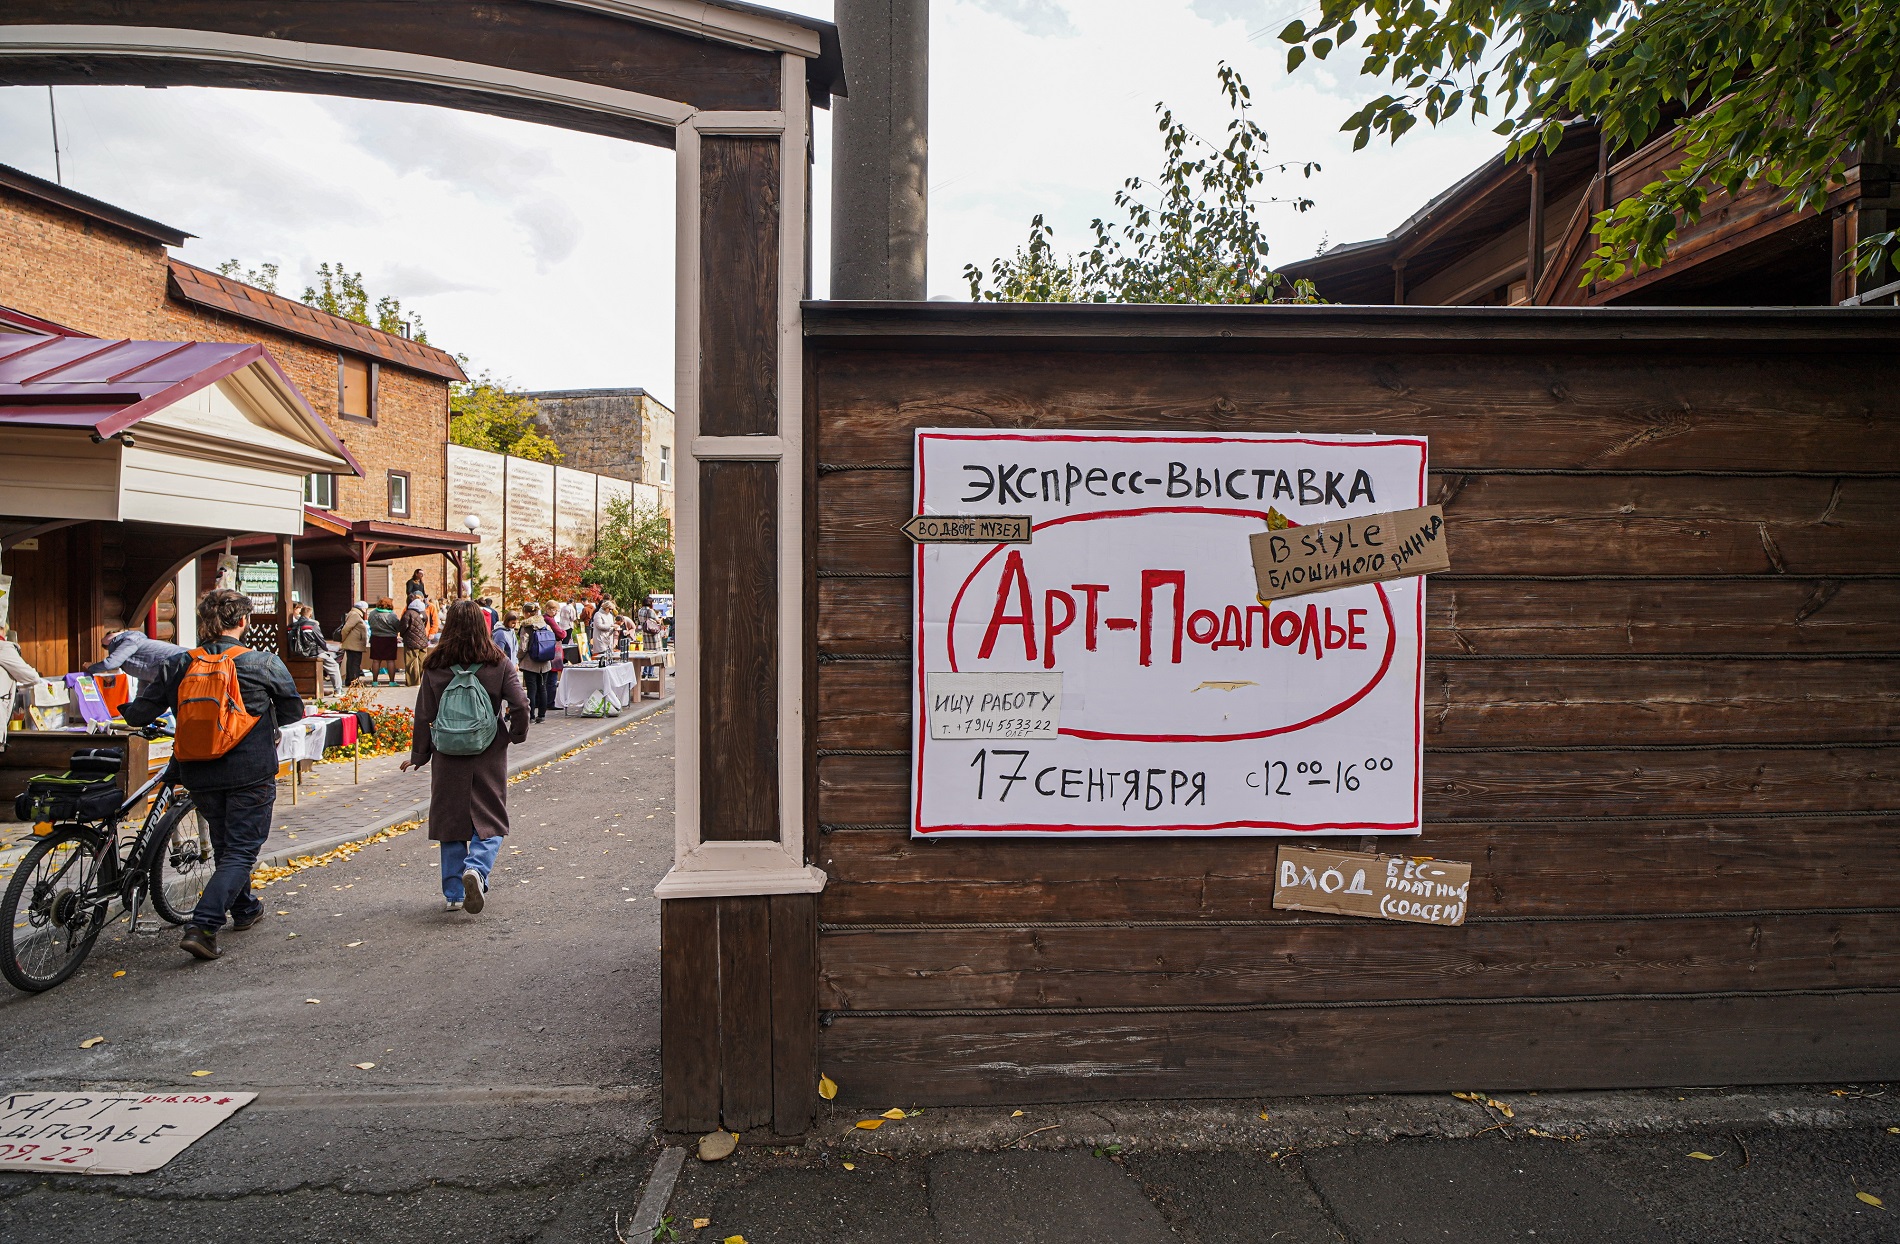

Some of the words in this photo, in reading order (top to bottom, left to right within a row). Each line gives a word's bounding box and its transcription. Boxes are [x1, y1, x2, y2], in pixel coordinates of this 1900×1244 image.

[919, 521, 939, 537] ВО
[980, 521, 1021, 538] МУЗЕЯ
[1268, 553, 1386, 590] БЛОШИНОГО
[1391, 515, 1443, 572] РЫНКА
[934, 694, 975, 714] ИЩУ
[980, 691, 1055, 712] РАБОТУ
[1005, 730, 1033, 738] ОЛЕГ
[1280, 860, 1373, 896] ВХОД
[1386, 858, 1446, 880] БЕС-
[1379, 893, 1464, 925] (СОВСЕМ)
[0, 1123, 177, 1144] ДПОЛЬЕ
